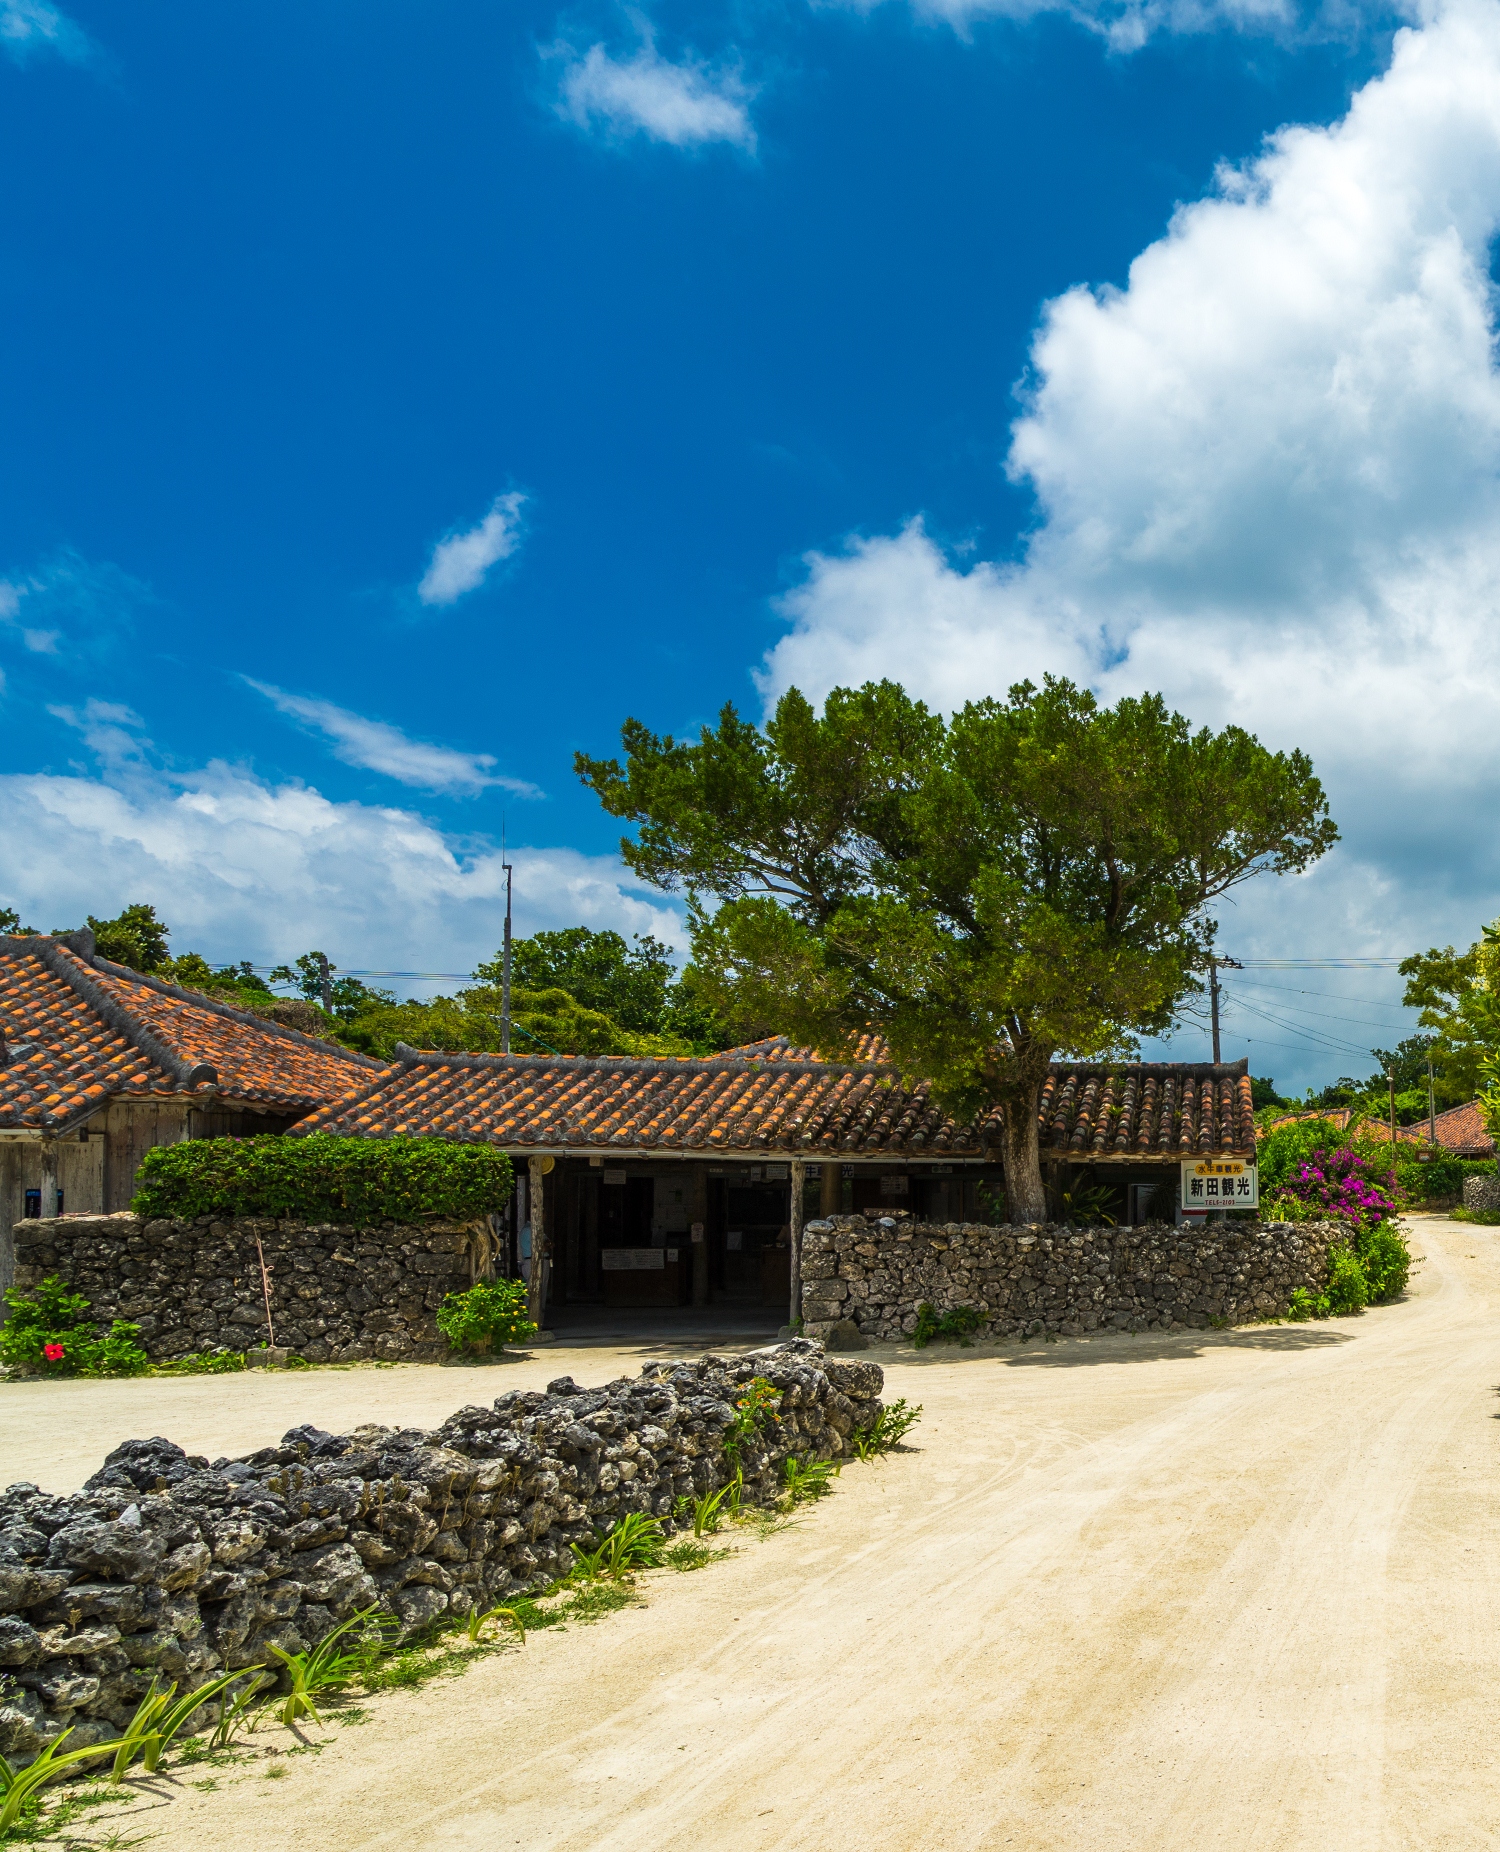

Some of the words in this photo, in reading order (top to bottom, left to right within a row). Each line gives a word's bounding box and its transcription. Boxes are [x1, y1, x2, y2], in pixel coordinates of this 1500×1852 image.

[1198, 1165, 1241, 1174] 水牛車観光
[1191, 1177, 1249, 1197] 新田観光
